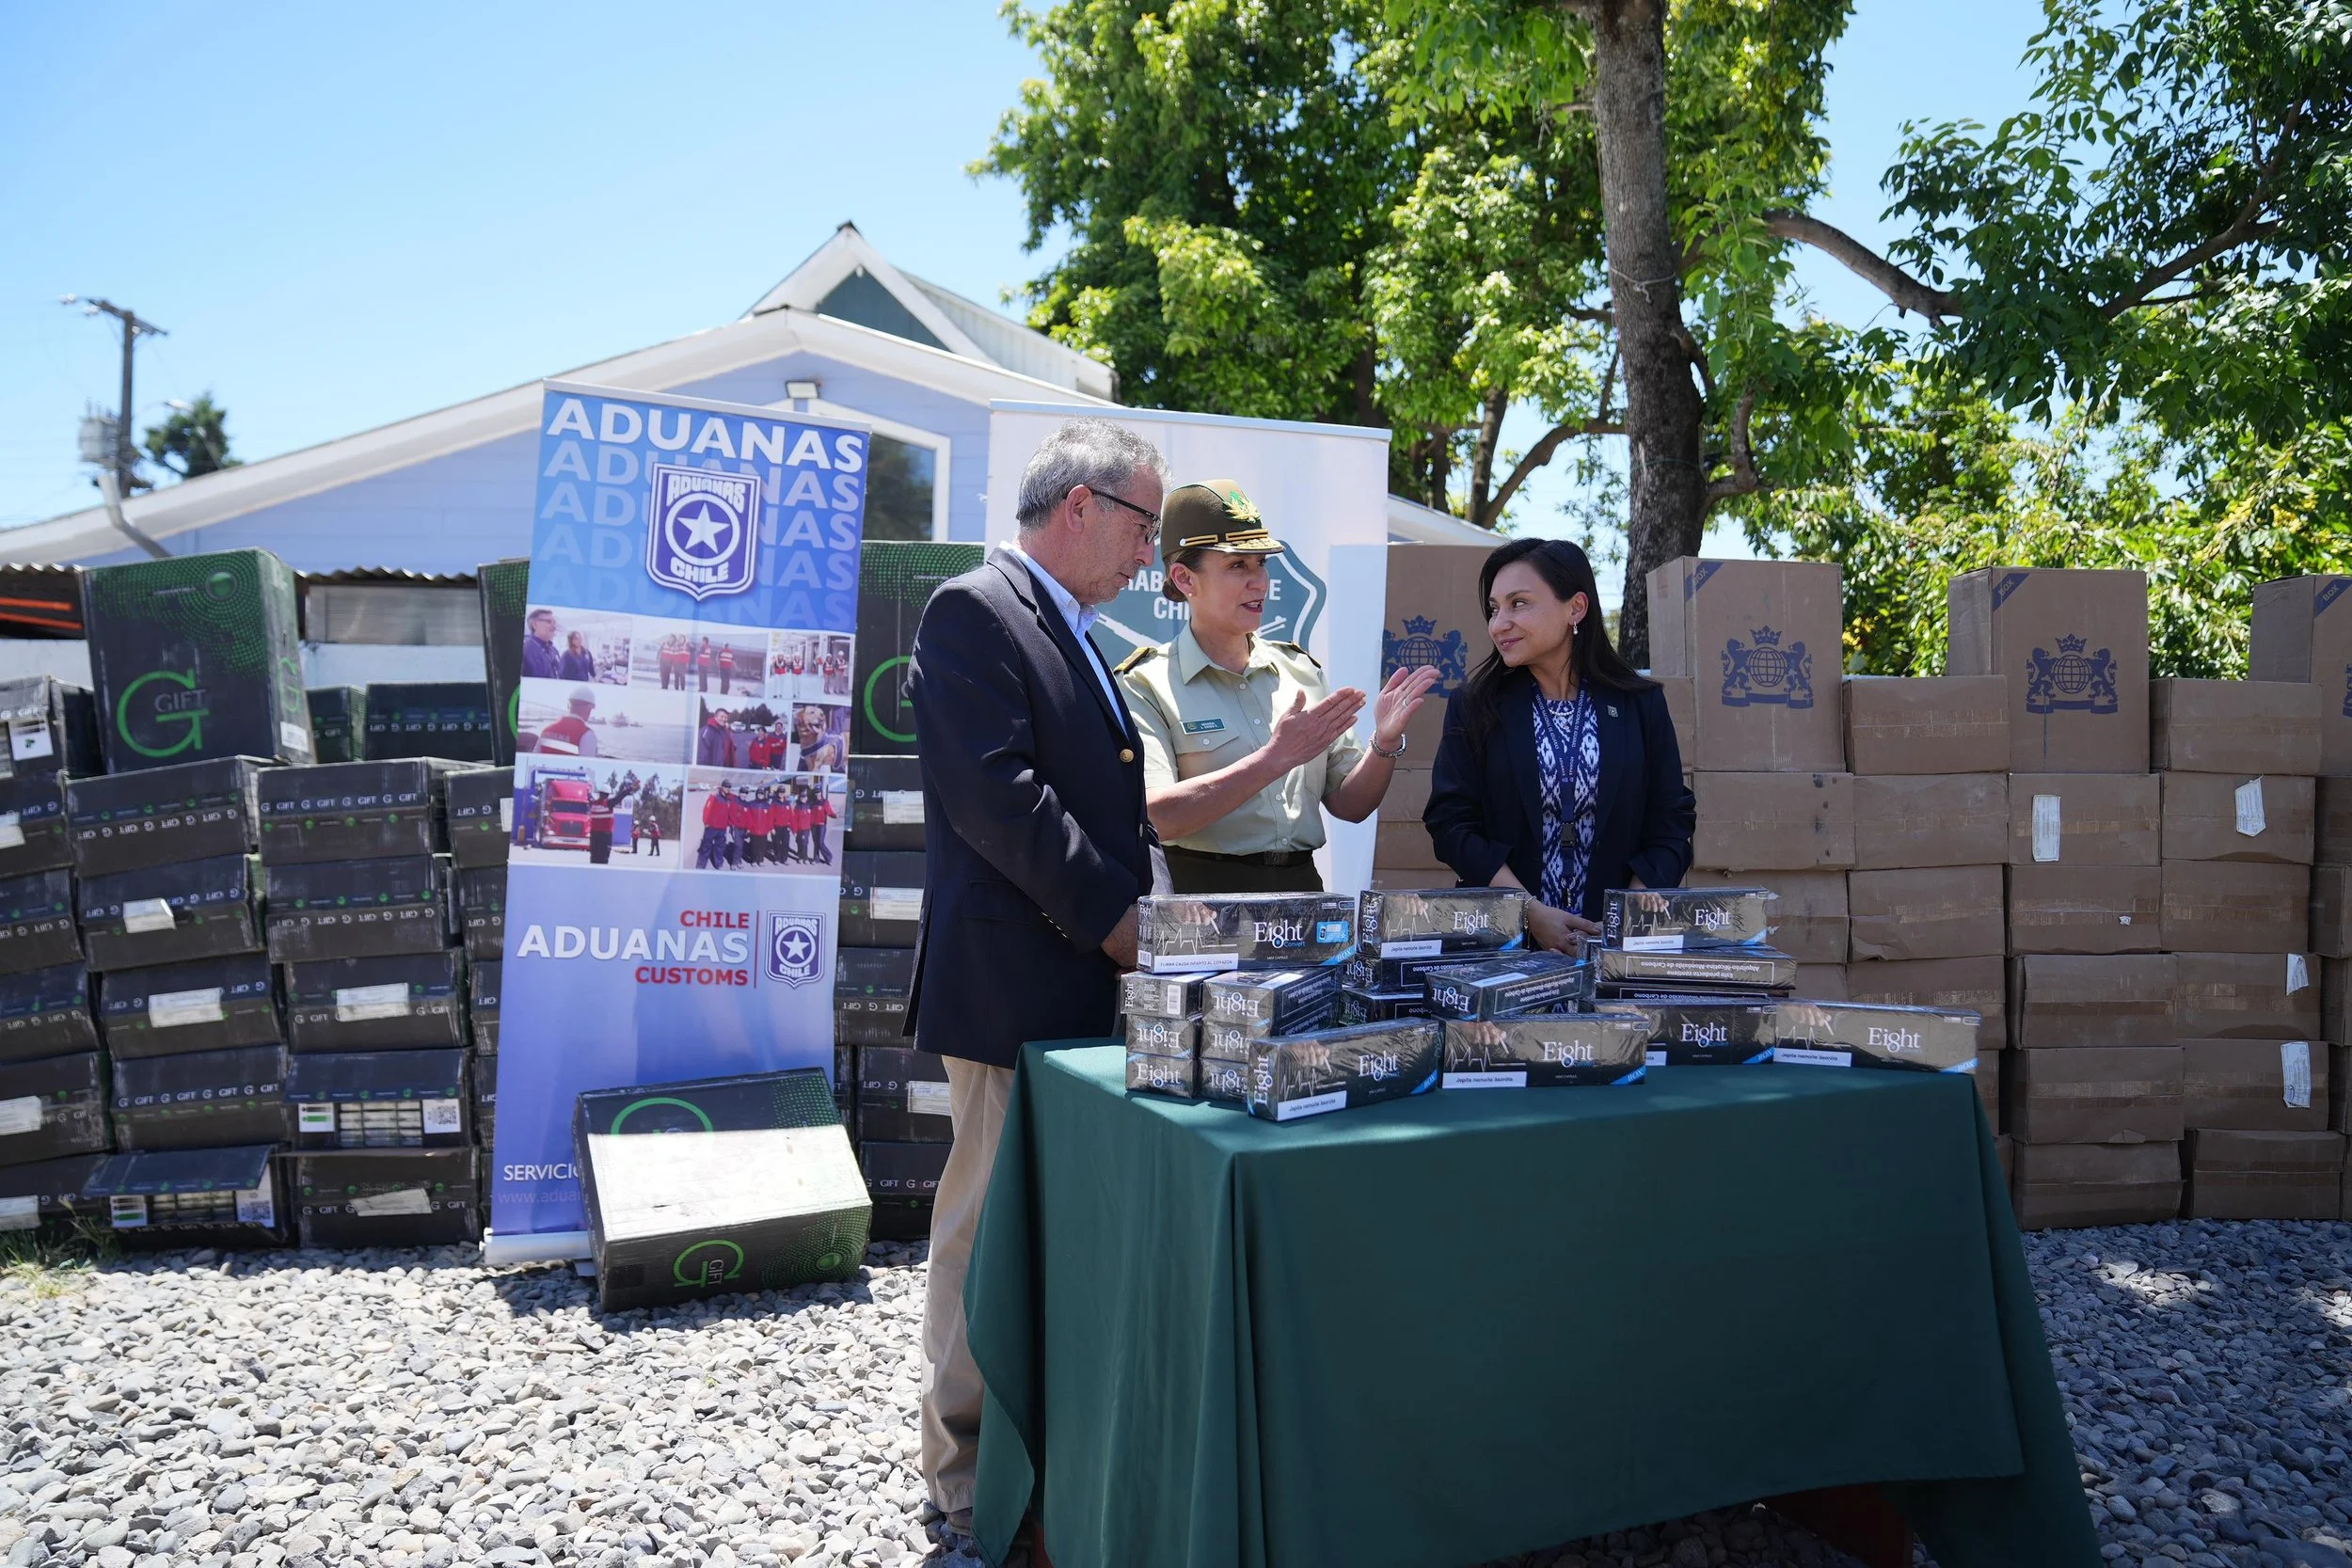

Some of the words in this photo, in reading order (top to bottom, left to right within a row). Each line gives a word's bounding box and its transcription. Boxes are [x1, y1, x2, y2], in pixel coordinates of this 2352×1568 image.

[546, 398, 863, 473] ADUANAS
[666, 474, 745, 514] ADUANAS
[539, 482, 858, 552] ADAS
[536, 523, 854, 592] ADAS
[670, 557, 730, 584] CHILE
[2323, 584, 2340, 601] BOX
[1153, 596, 1191, 621] CHI
[154, 689, 207, 712] GIFT
[679, 911, 750, 928] CHILE
[775, 916, 818, 937] ADUANAS
[1453, 910, 1489, 935] Eight
[1607, 901, 1621, 941] Eight
[1694, 907, 1731, 931] Eight
[516, 925, 749, 964] ADUANAS
[1253, 920, 1303, 949] Eight
[1336, 948, 1353, 962] BOX
[635, 966, 749, 987] CUSTOMS
[779, 962, 811, 979] CHILE
[1345, 960, 1374, 983] Eight
[1124, 983, 1135, 1008] Eight
[1214, 992, 1260, 1018] Eight
[1432, 987, 1470, 1012] Eight
[1137, 1022, 1180, 1048] Eight
[1680, 1022, 1728, 1048] Eight
[1867, 1026, 1921, 1053] Eight
[1359, 1051, 1399, 1082] Eight
[1542, 1039, 1595, 1068] Eight
[1136, 1063, 1181, 1086] Eight
[1254, 1054, 1273, 1104] Eight
[880, 1179, 898, 1187] GIFT
[906, 1180, 915, 1188] G
[708, 1259, 723, 1286] GIFT
